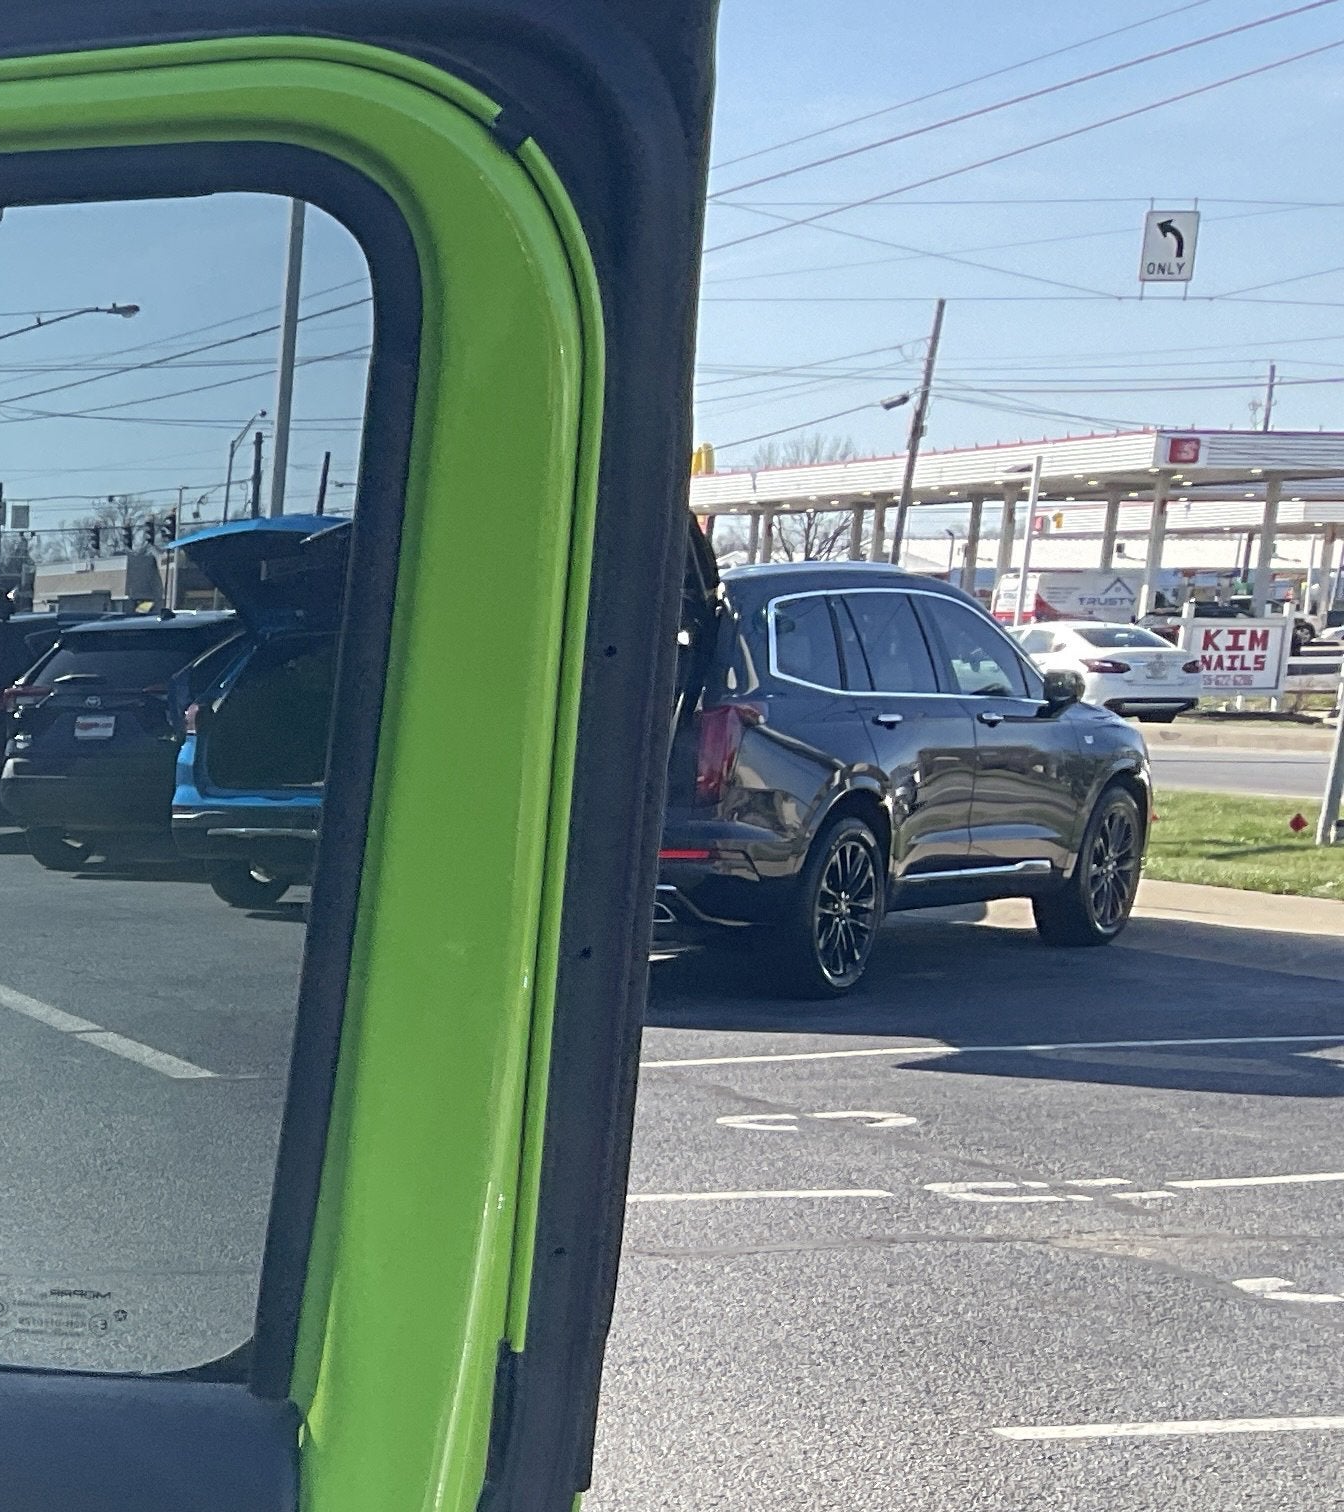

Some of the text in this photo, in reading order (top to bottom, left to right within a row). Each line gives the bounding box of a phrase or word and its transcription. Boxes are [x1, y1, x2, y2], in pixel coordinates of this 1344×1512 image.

[1147, 262, 1186, 275] ONLY
[1078, 597, 1137, 606] TRUSTY
[1201, 629, 1270, 651] KIM
[1200, 654, 1267, 671] NAILS
